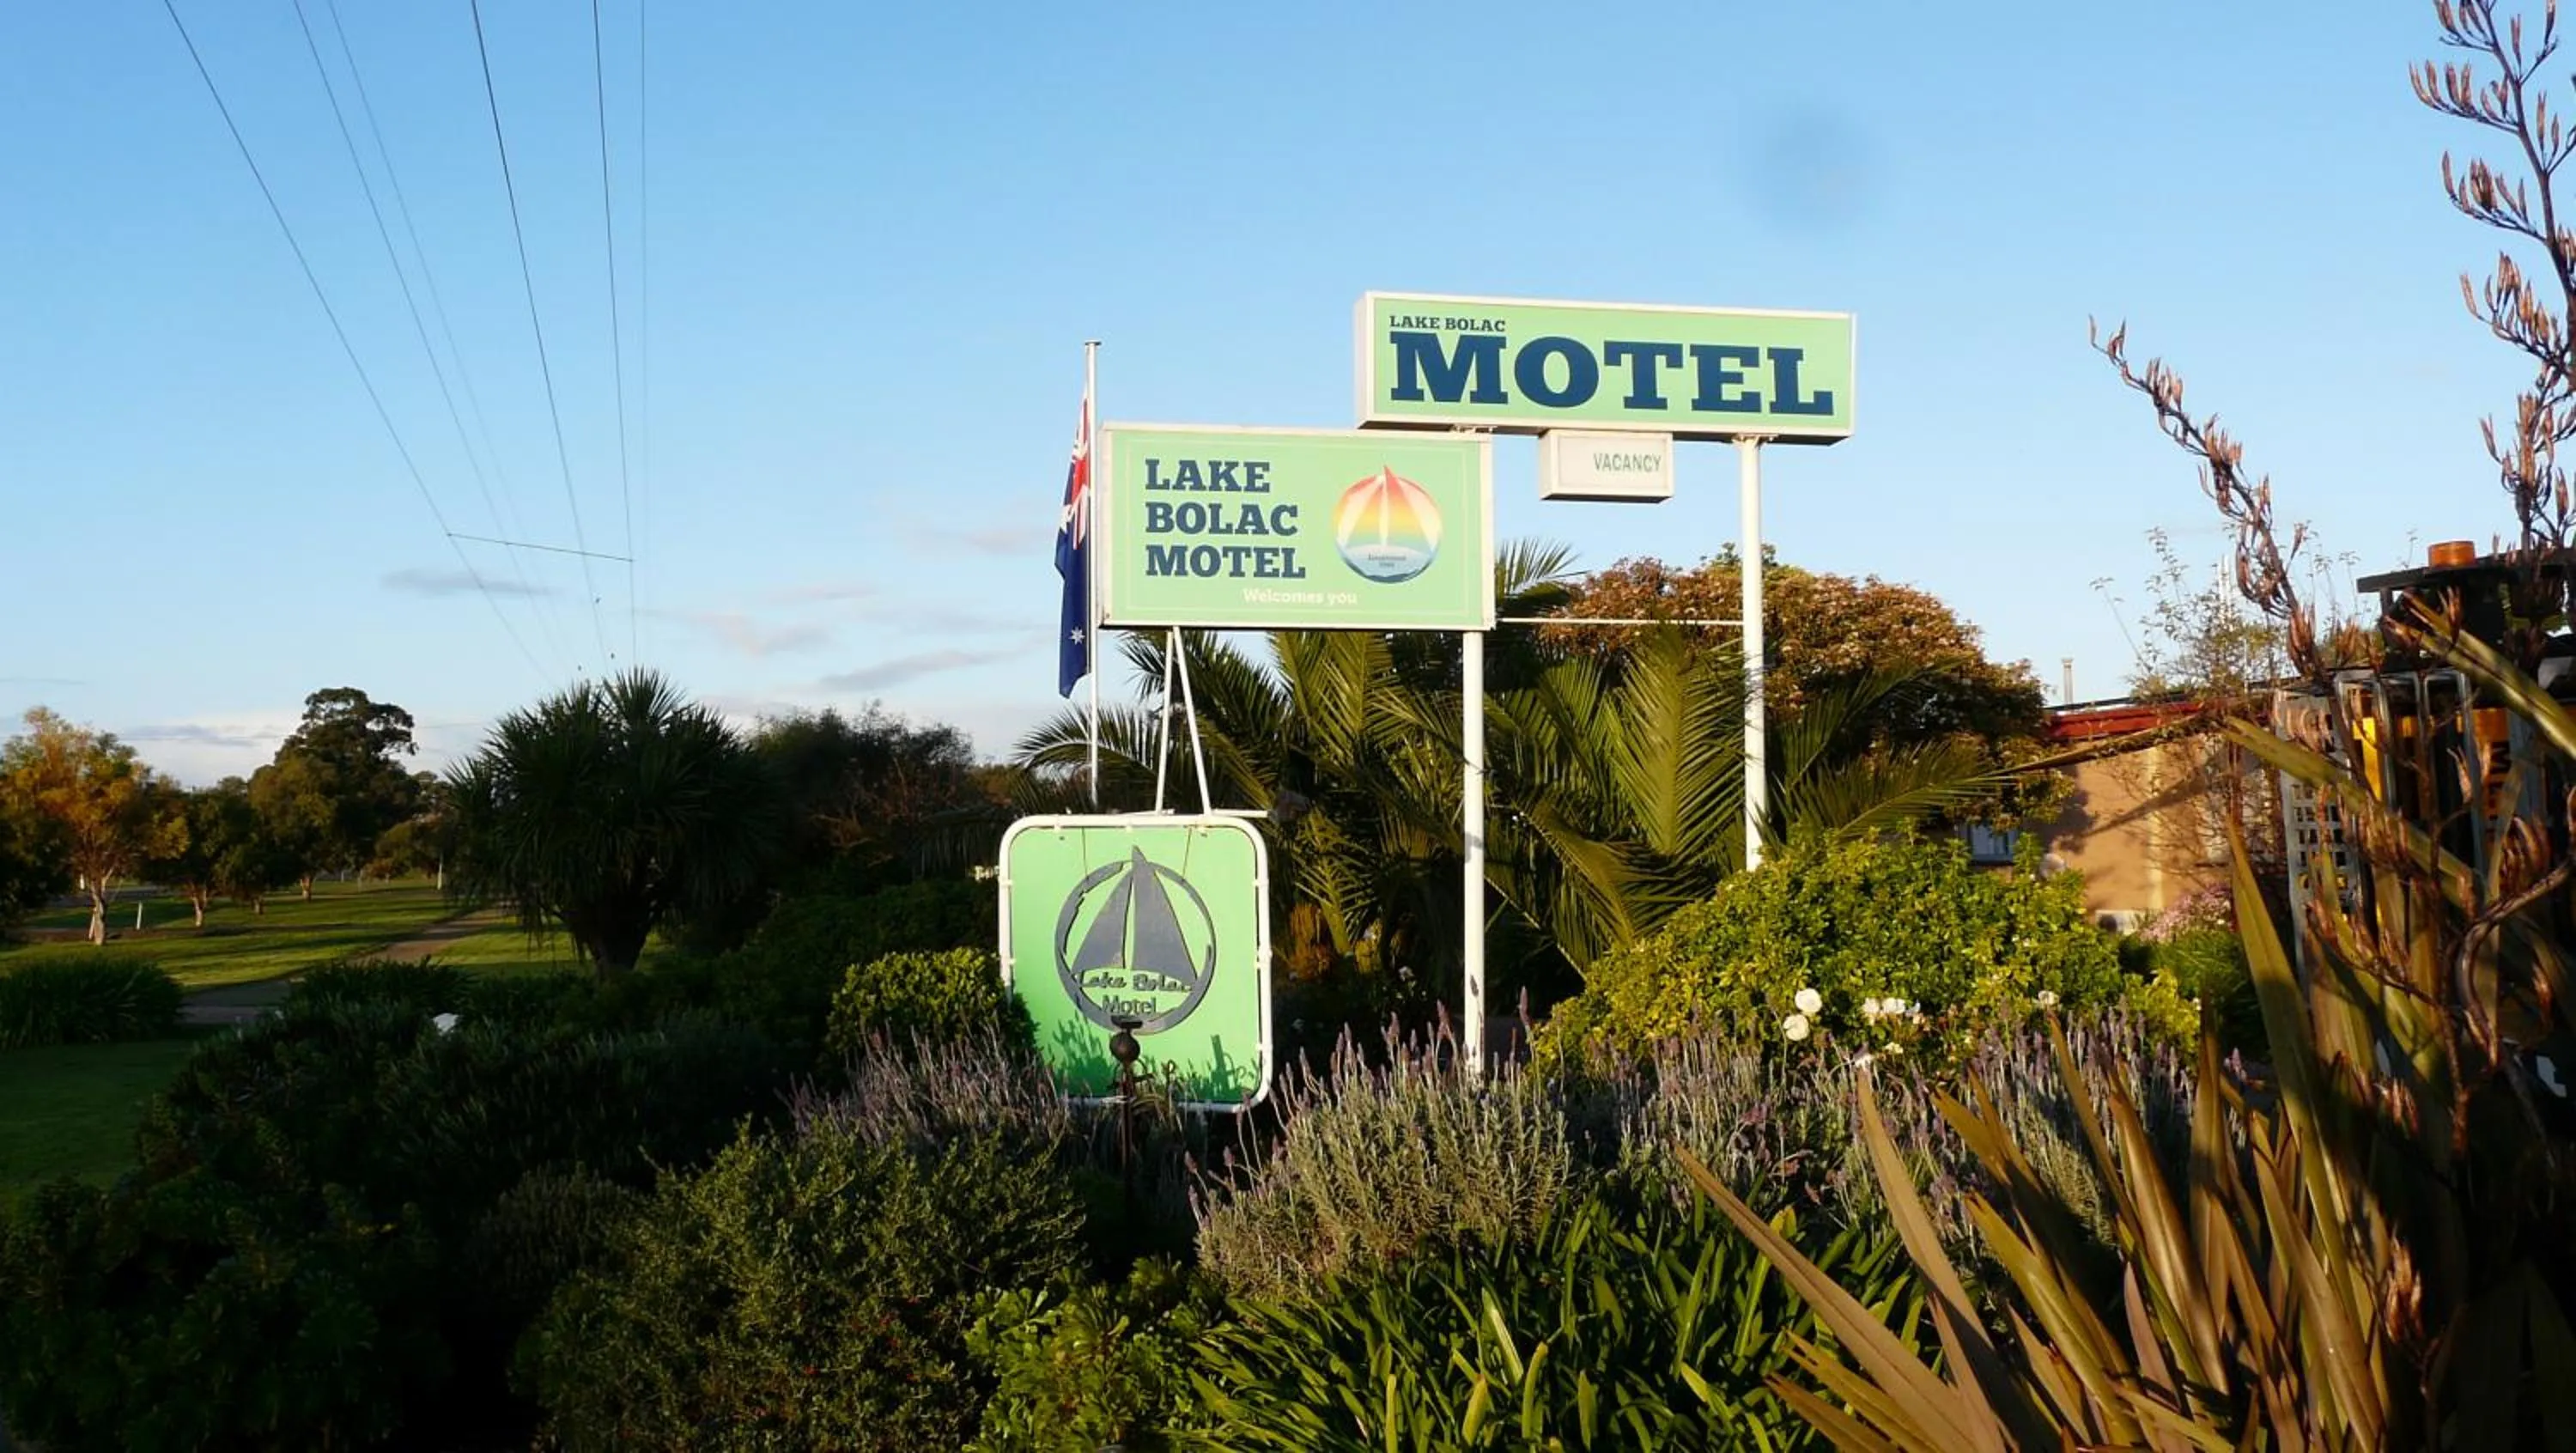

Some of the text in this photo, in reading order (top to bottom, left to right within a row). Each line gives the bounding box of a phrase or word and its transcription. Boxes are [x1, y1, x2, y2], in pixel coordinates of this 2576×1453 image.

[1389, 314, 1506, 332] LAKE BOLAC
[1389, 331, 1834, 416] MOTEL
[1593, 453, 1662, 473] VACANCY
[1145, 458, 1270, 493] LAKE
[1145, 502, 1298, 536] BOLAC
[1145, 544, 1306, 579] MOTEL
[1242, 587, 1358, 606] Welcomes you
[1077, 970, 1127, 988] Lake
[1101, 994, 1157, 1015] Motel
